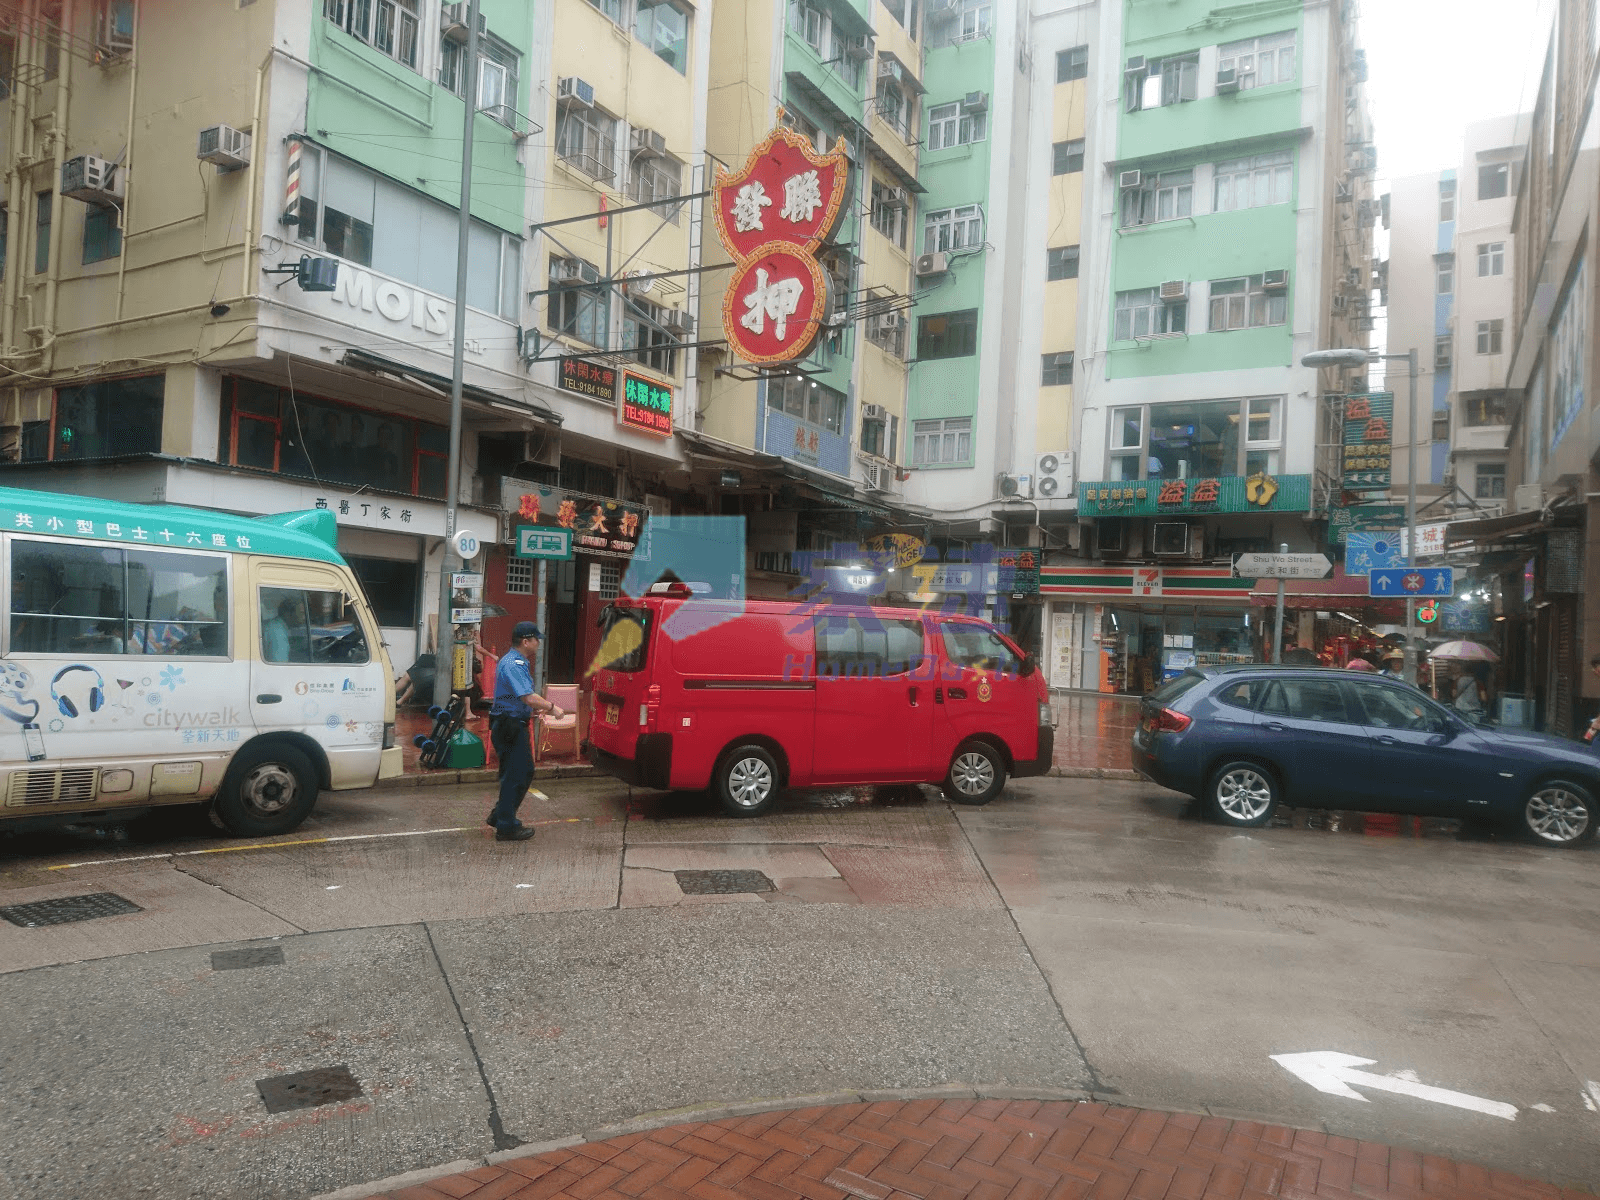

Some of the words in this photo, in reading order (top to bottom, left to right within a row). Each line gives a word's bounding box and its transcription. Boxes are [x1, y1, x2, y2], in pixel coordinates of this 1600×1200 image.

[331, 263, 448, 335] MOIS
[741, 267, 804, 341] 押
[596, 387, 612, 399] 1890
[15, 512, 252, 549] 共小型巴士十六座位
[460, 538, 476, 552] 80
[1137, 569, 1159, 595] 7
[1265, 566, 1299, 575] 兆和街
[142, 705, 241, 733] citywalk
[181, 729, 241, 744] 荃新天地
